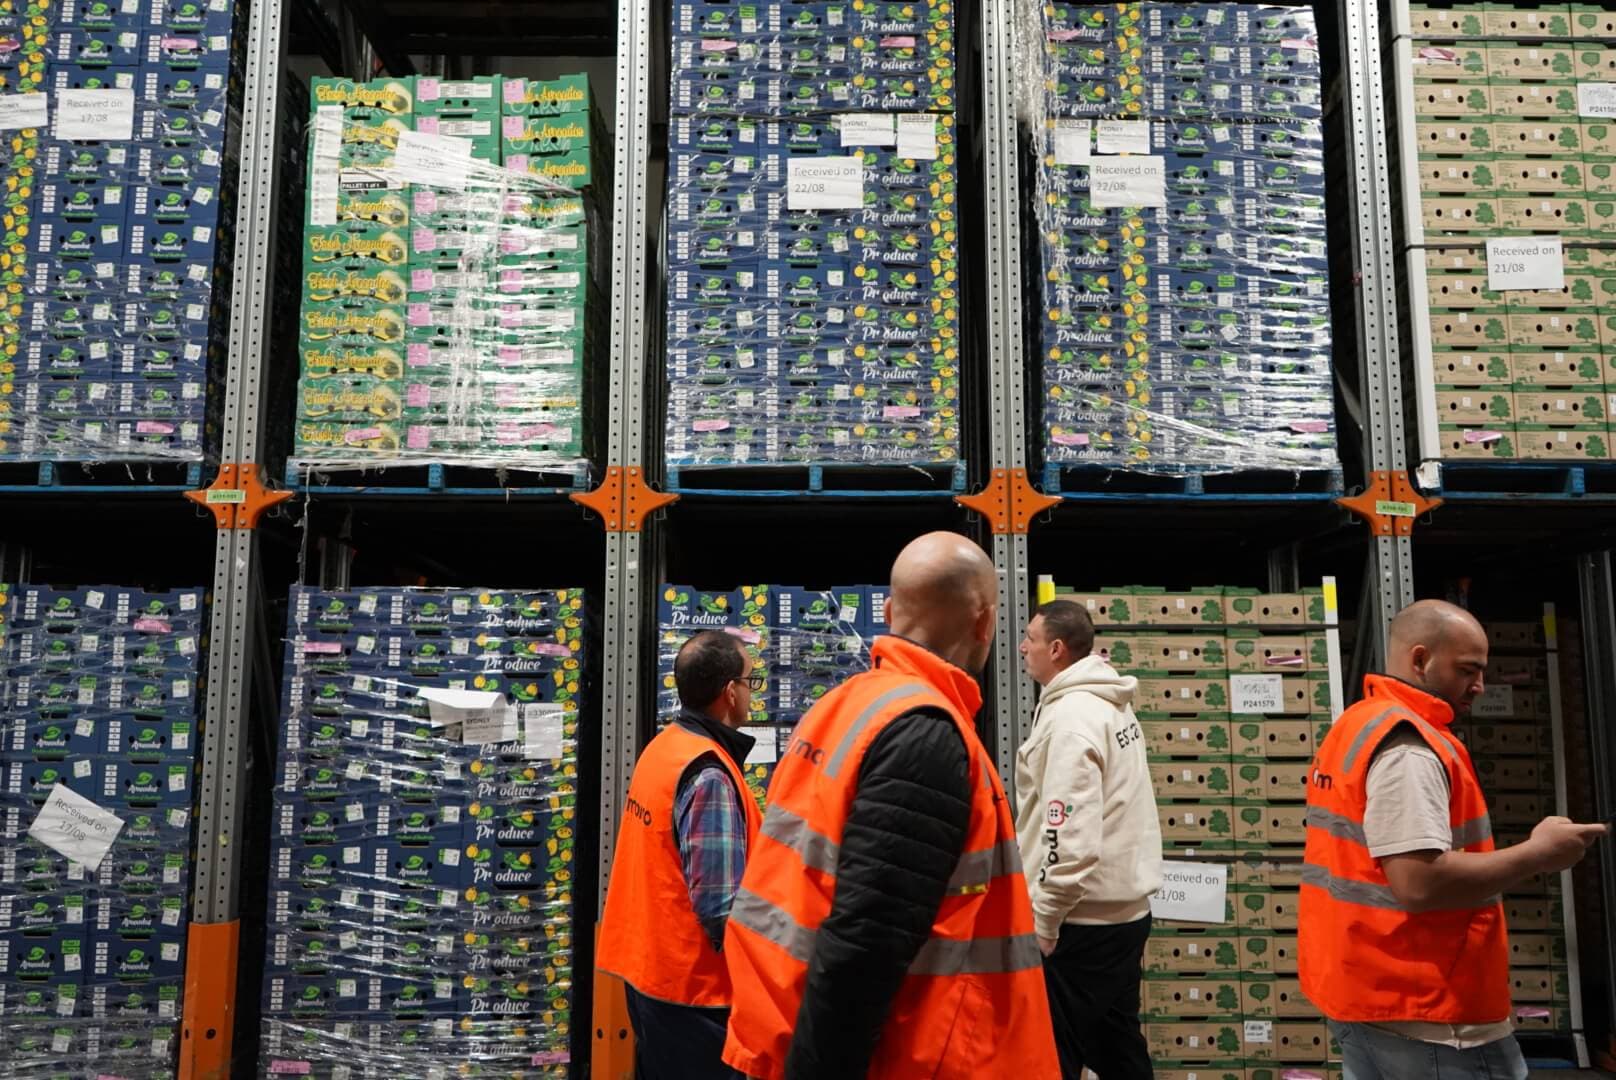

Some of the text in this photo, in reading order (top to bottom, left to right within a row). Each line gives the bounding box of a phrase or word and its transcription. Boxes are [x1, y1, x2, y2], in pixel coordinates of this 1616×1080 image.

[843, 167, 857, 176] on
[1095, 165, 1157, 175] Received on
[794, 182, 825, 194] 22/08
[1095, 181, 1127, 192] 22/08
[1493, 245, 1555, 256] Received on
[1494, 262, 1526, 274] 21/08
[1243, 700, 1275, 708] P241579
[55, 797, 108, 833] Received on
[58, 819, 87, 841] 17/08
[1161, 872, 1219, 885] eceived on
[1153, 889, 1186, 901] 21/08
